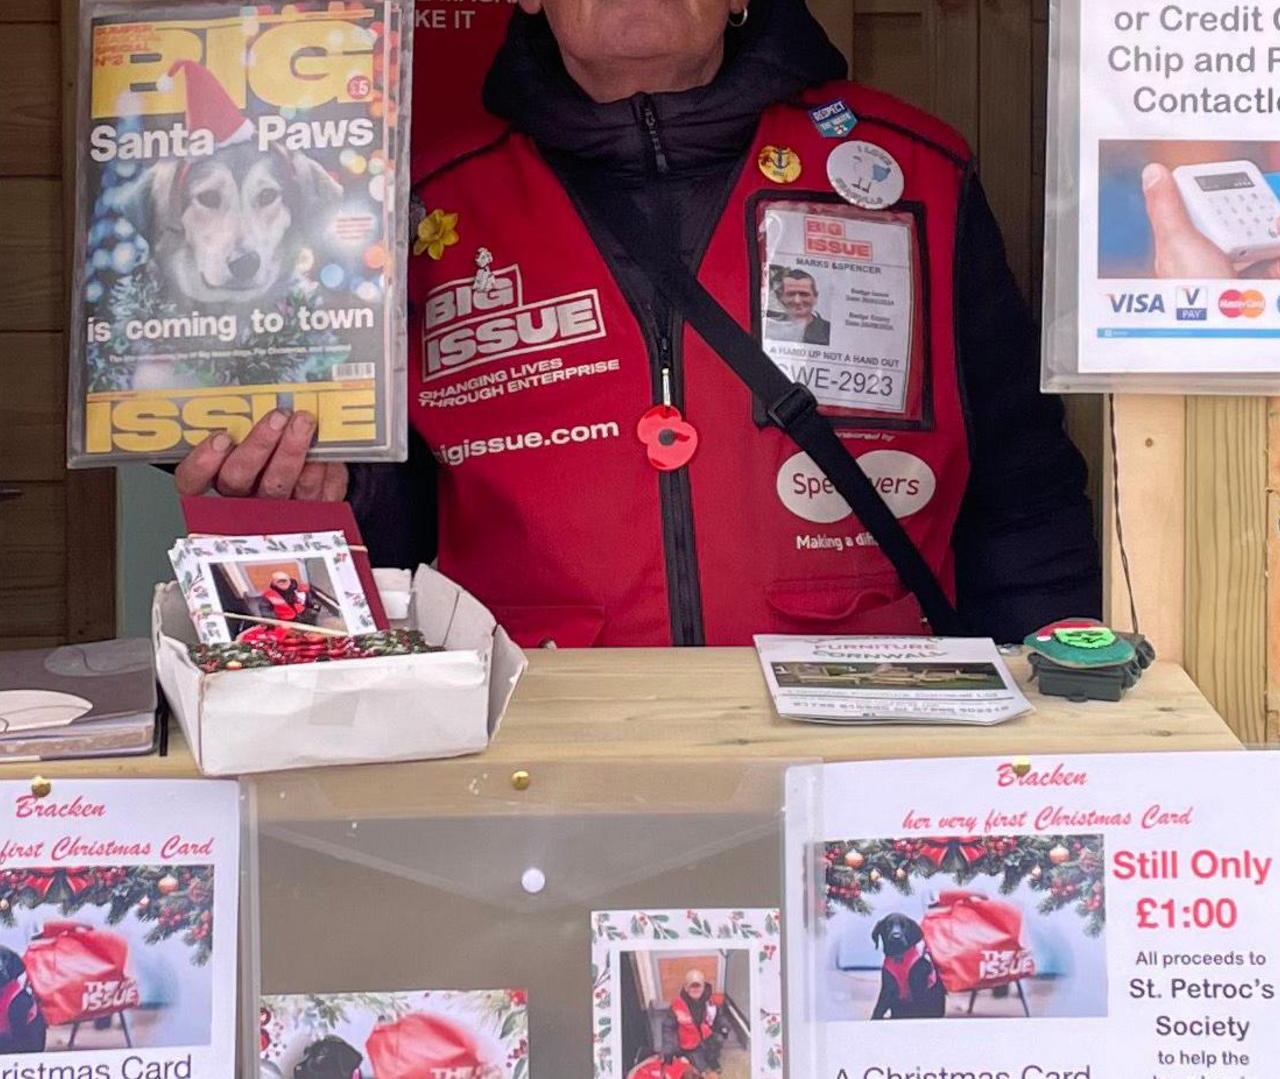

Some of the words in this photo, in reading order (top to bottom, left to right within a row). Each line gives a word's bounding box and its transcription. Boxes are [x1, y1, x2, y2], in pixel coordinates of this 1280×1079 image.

[455, 11, 476, 29] IT
[1114, 9, 1149, 30] or
[1159, 5, 1263, 32] Credit
[92, 20, 375, 118] BIG
[1108, 46, 1184, 78] Chip
[1194, 47, 1255, 74] and
[90, 124, 214, 162] Santa
[258, 116, 374, 151] Paws
[807, 221, 842, 236] BIG
[808, 238, 870, 257] ISSUE
[426, 278, 514, 329] BIG
[1107, 294, 1165, 313] VISA
[1183, 288, 1199, 306] V
[87, 317, 111, 343] is
[126, 311, 236, 341] coming
[251, 309, 283, 332] to
[297, 306, 374, 330] town
[1182, 310, 1200, 319] PAY
[427, 299, 598, 373] ISSUE
[823, 352, 842, 361] NOT
[853, 356, 878, 365] HAND
[881, 358, 899, 367] OUT
[419, 370, 508, 400] CHANGING
[511, 358, 563, 378] LIVES
[419, 385, 504, 408] THROUGH
[508, 359, 620, 393] ENTERPRISE
[793, 473, 919, 499] Spevers
[797, 534, 843, 551] Making
[845, 536, 853, 546] a
[16, 795, 106, 819] Bracken
[902, 809, 932, 830] her
[937, 812, 979, 834] very
[984, 809, 1029, 834] first
[1033, 807, 1133, 831] Christmas
[1141, 804, 1194, 829] Card
[51, 836, 152, 862] Christmas
[159, 834, 215, 860] Card
[1112, 850, 1178, 880] Still
[1191, 849, 1272, 885] Only
[1136, 897, 1238, 929] £1:00
[1136, 952, 1157, 965] All
[1163, 951, 1244, 968] proceeds
[1250, 952, 1266, 965] to
[1129, 978, 1162, 998] St.
[1171, 978, 1274, 999] Petroc’s
[1156, 1016, 1250, 1041] Society
[121, 1054, 192, 1079] Card
[1158, 1051, 1174, 1065] to
[1180, 1050, 1217, 1066] help
[1222, 1051, 1249, 1065] the
